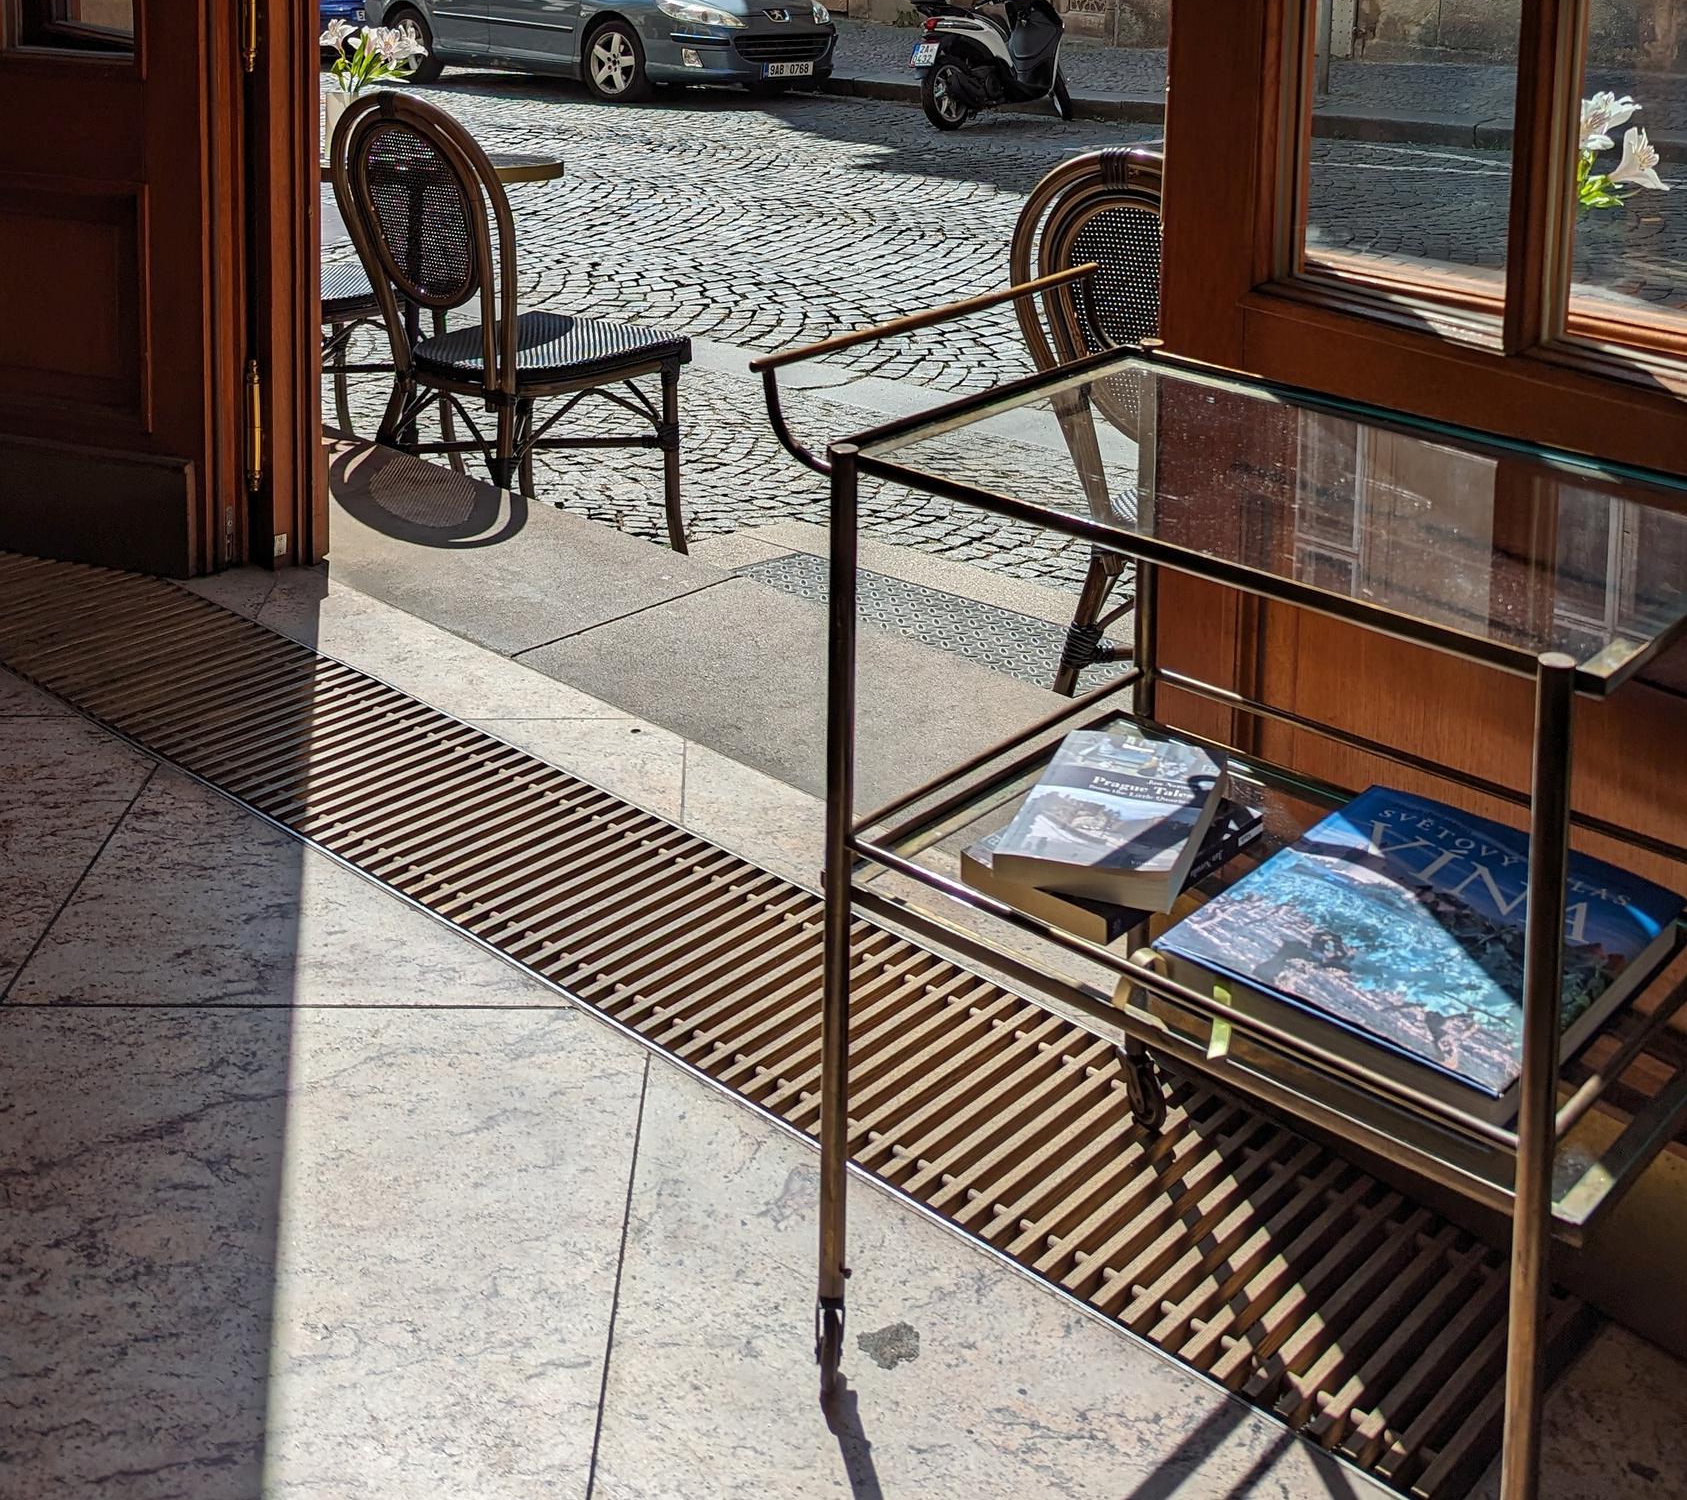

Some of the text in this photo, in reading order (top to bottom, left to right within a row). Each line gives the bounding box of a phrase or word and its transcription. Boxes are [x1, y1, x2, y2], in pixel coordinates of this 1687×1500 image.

[1092, 775, 1195, 798] Prague Tales
[1378, 808, 1528, 867] SVĚTOVÝ
